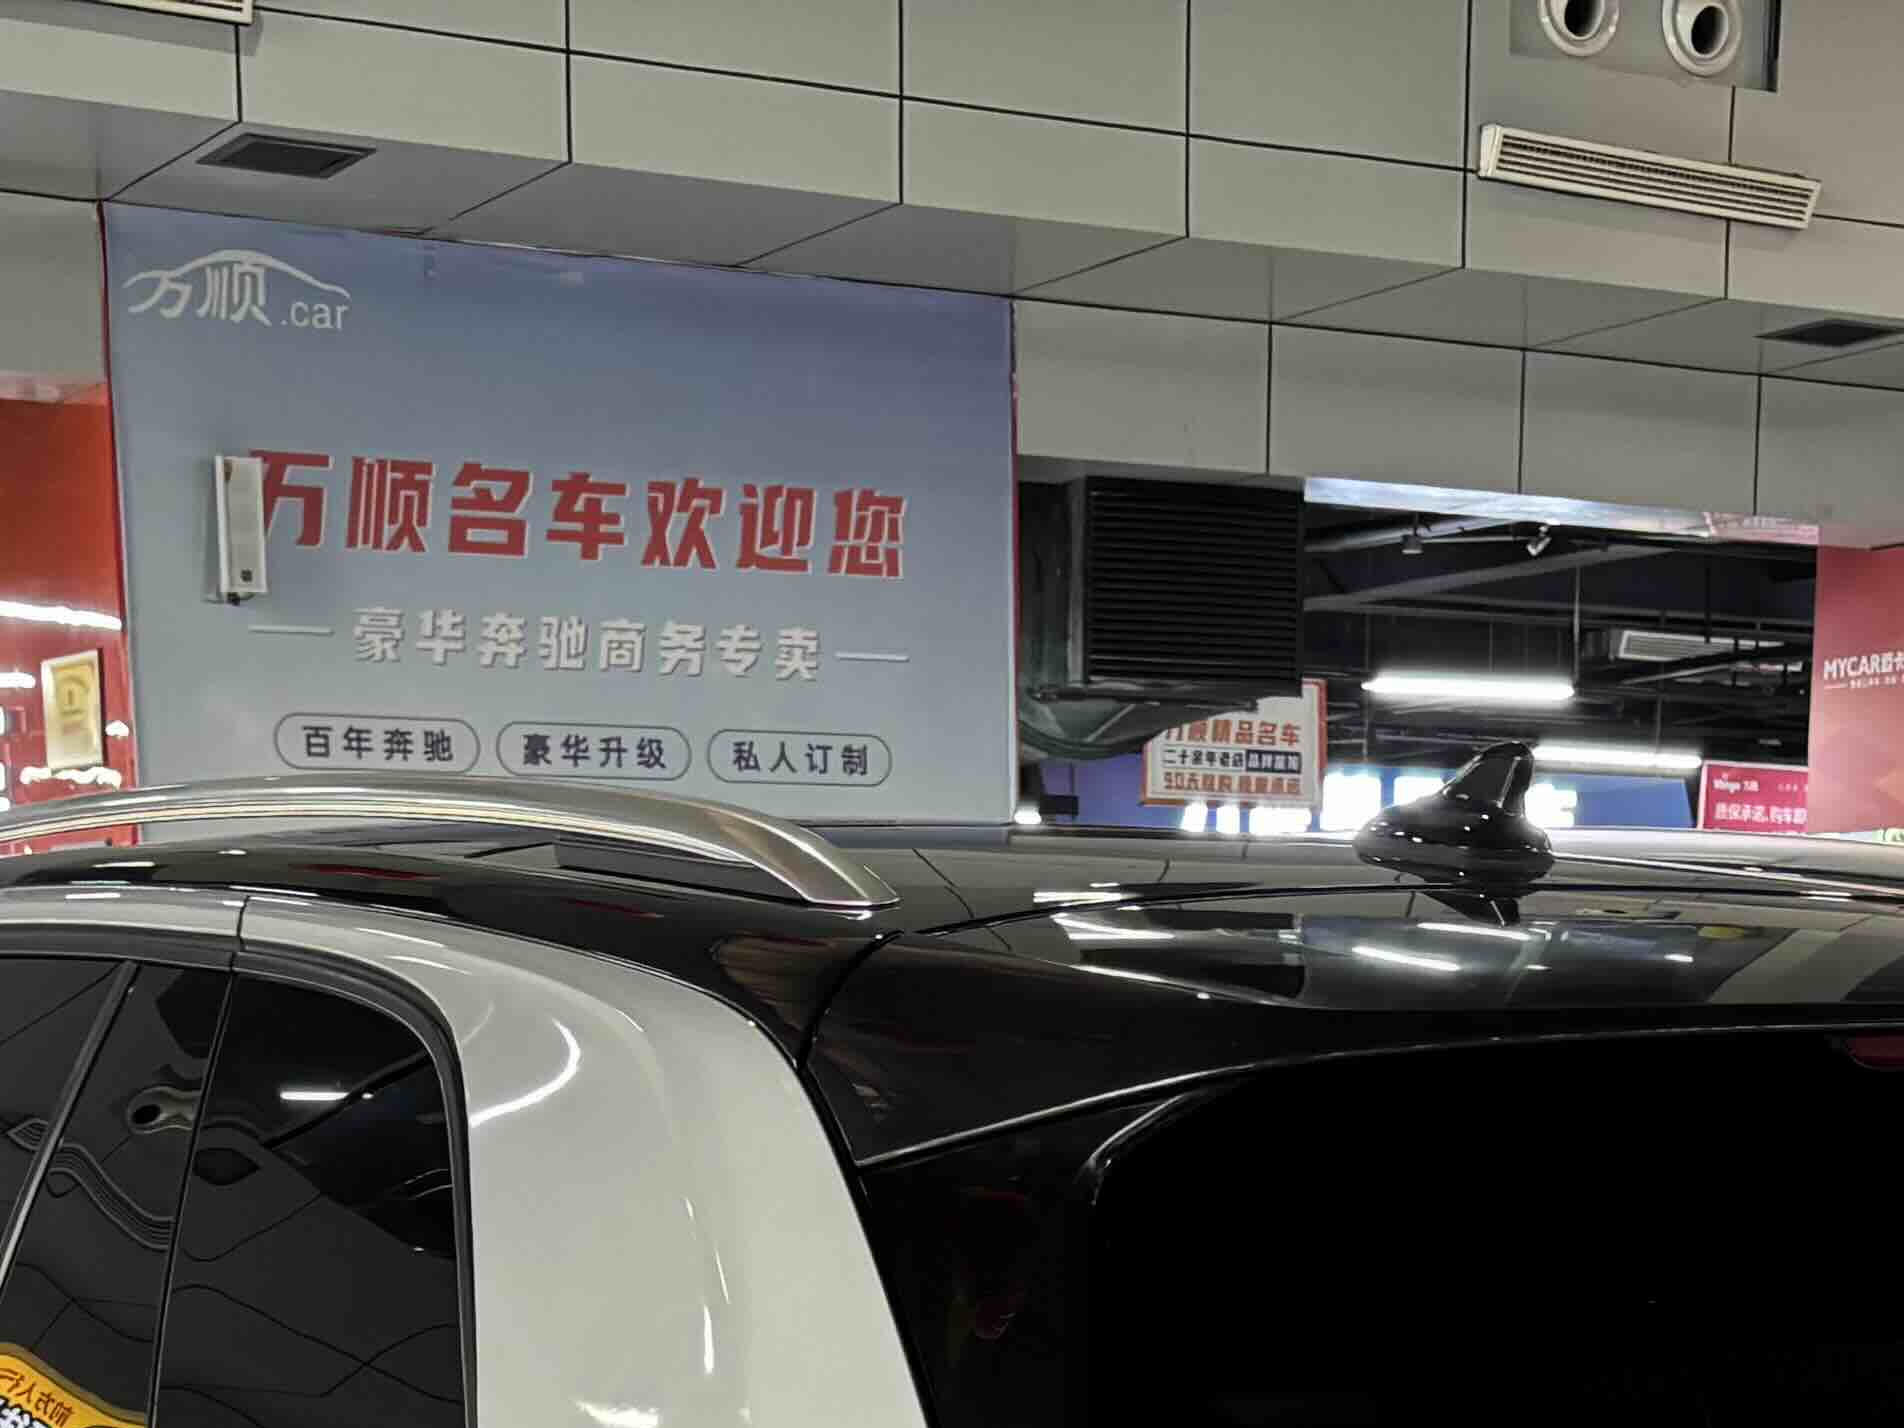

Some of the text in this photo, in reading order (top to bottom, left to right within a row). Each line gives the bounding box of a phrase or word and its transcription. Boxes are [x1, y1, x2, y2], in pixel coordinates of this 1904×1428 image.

[248, 450, 906, 579] 万顺名车欢迎您
[353, 607, 822, 680] 豪华奔驰商务专卖
[301, 725, 455, 764] 百年奔驰
[523, 732, 666, 770] 豪华升级
[732, 740, 870, 777] 私人订制
